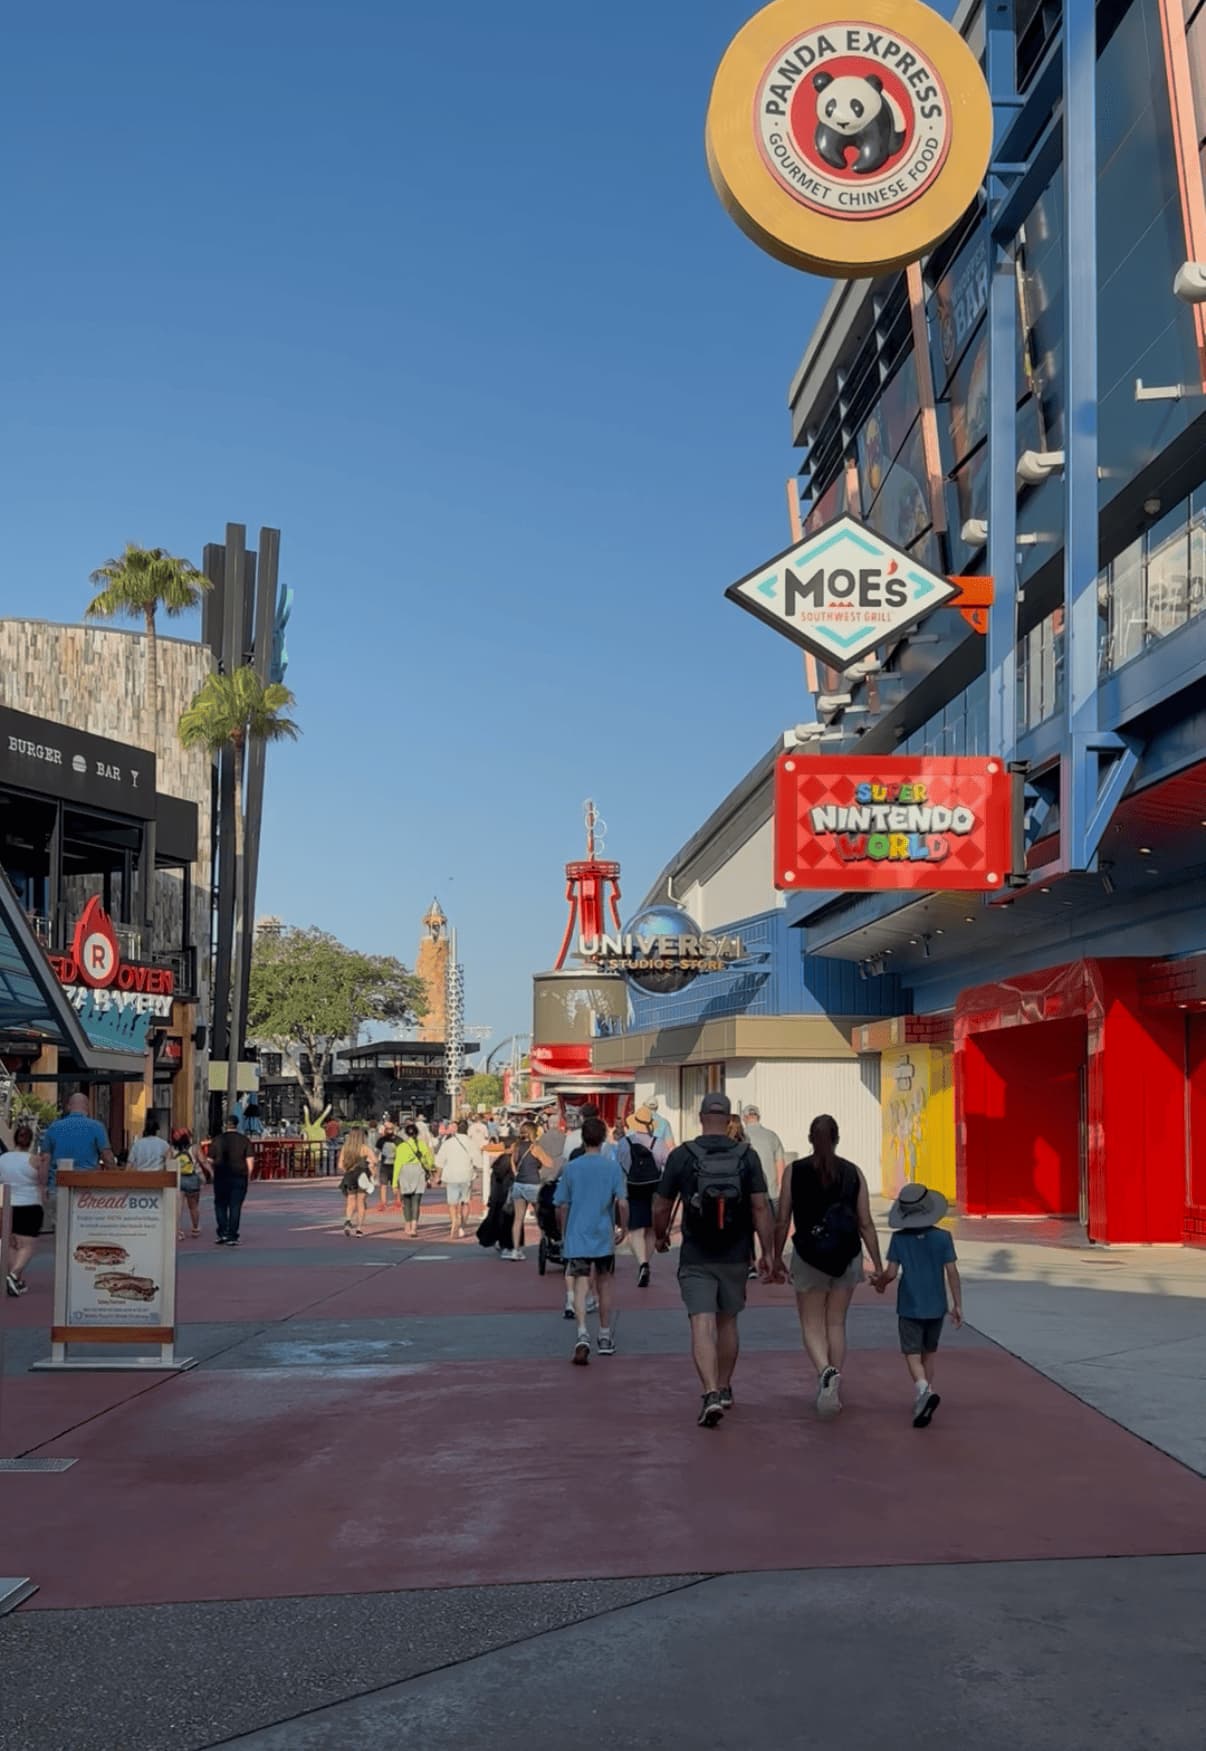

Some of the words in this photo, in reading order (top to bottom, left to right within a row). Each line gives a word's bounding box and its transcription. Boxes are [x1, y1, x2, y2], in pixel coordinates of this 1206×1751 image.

[765, 34, 837, 116] PANDA
[846, 30, 942, 119] EXPRESS
[768, 132, 832, 200] GOURMET
[838, 180, 908, 206] CHINESE
[908, 136, 939, 182] FOOD
[801, 611, 861, 623] SOUTHWEST
[863, 611, 892, 623] GRILL
[8, 735, 62, 765] BURGER
[96, 761, 121, 781] BAR
[856, 782, 928, 804] SUPER
[811, 804, 976, 836] NINTENDO
[836, 832, 950, 861] WORLD
[91, 944, 106, 970] R
[609, 959, 674, 970] STUDIOS
[680, 959, 726, 970] STORE
[118, 963, 174, 994] OVEN
[129, 1196, 159, 1209] BOX
